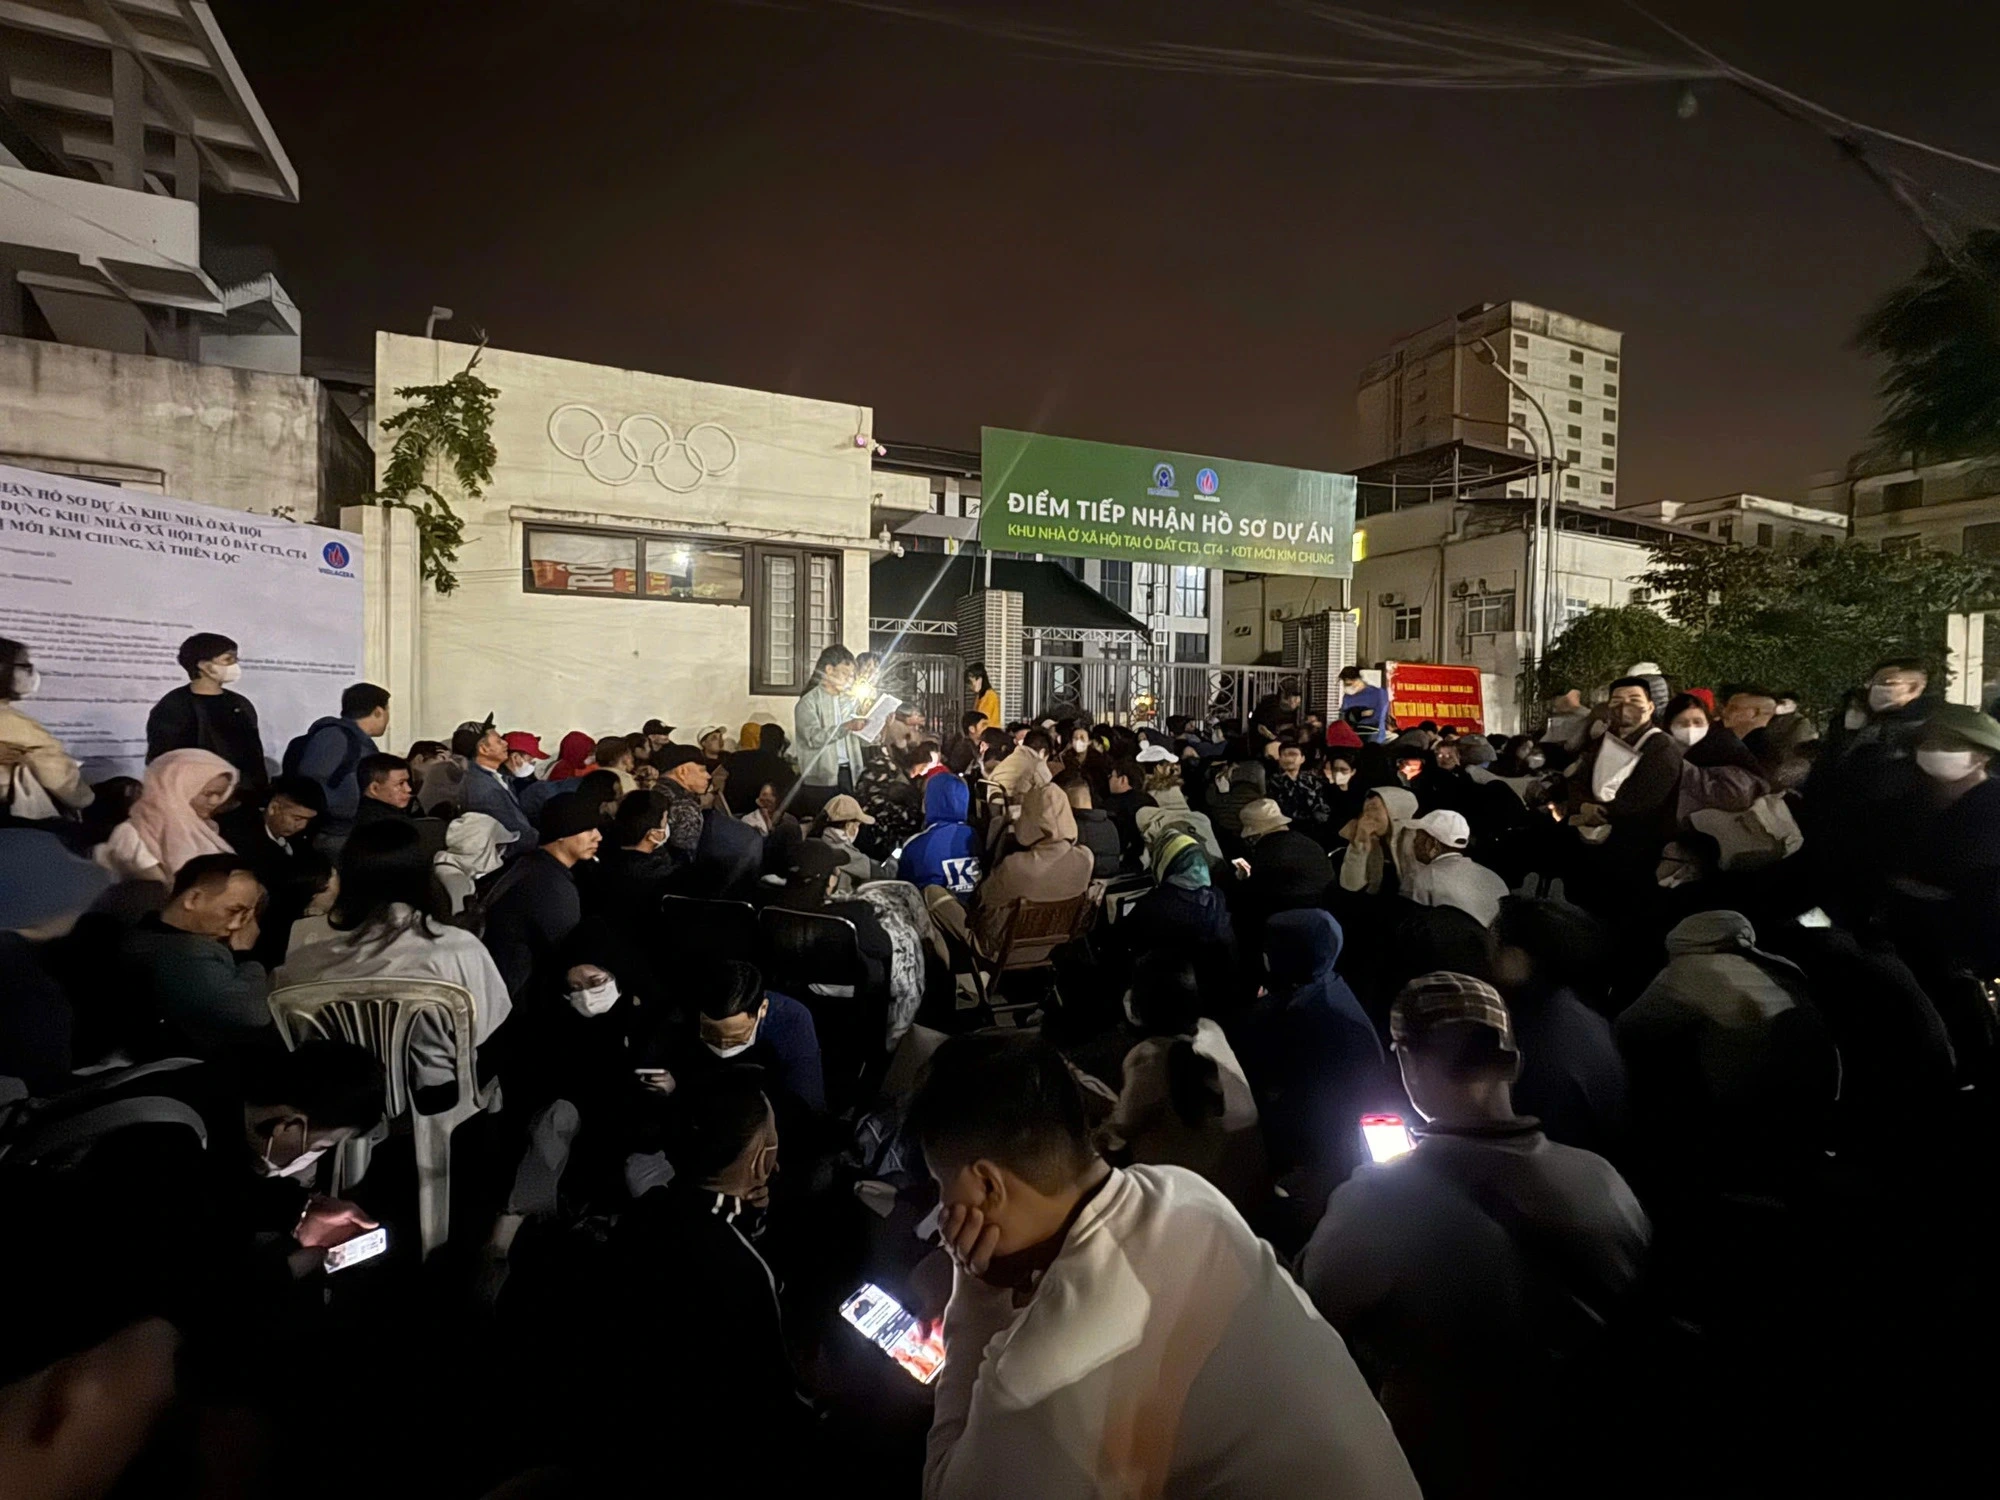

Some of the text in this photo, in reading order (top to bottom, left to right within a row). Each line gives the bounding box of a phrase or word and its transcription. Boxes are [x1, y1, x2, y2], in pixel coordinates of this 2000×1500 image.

[66, 495, 87, 507] SƠ
[91, 498, 114, 513] DỰ
[141, 508, 171, 521] KHU
[1007, 489, 1334, 546] ĐIỂM TIẾP NHẬN HỒ SƠ DỰ ÁN
[10, 518, 43, 534] MỚI
[49, 525, 82, 541] KIM
[85, 532, 143, 549] CHUNG,
[169, 544, 211, 559] THIÊN
[55, 509, 90, 524] KHU
[94, 515, 126, 530] NHÀ
[168, 528, 193, 541] HỘI
[195, 533, 218, 546] TẠI
[286, 548, 308, 559] CT4
[1008, 523, 1036, 538] KHU
[1038, 525, 1067, 541] NHÀ
[1068, 527, 1080, 542] Ở
[1081, 529, 1098, 544] XÃ
[1099, 530, 1122, 548] HỘI
[1123, 535, 1141, 550] TẠI
[1143, 534, 1153, 549] Ô
[1155, 536, 1178, 551] ĐẤT
[1203, 543, 1223, 556] CT4
[1231, 545, 1253, 559] KĐT
[1254, 546, 1276, 561] MỚI
[1277, 548, 1297, 563] KIM
[1298, 551, 1335, 565] CHUNG
